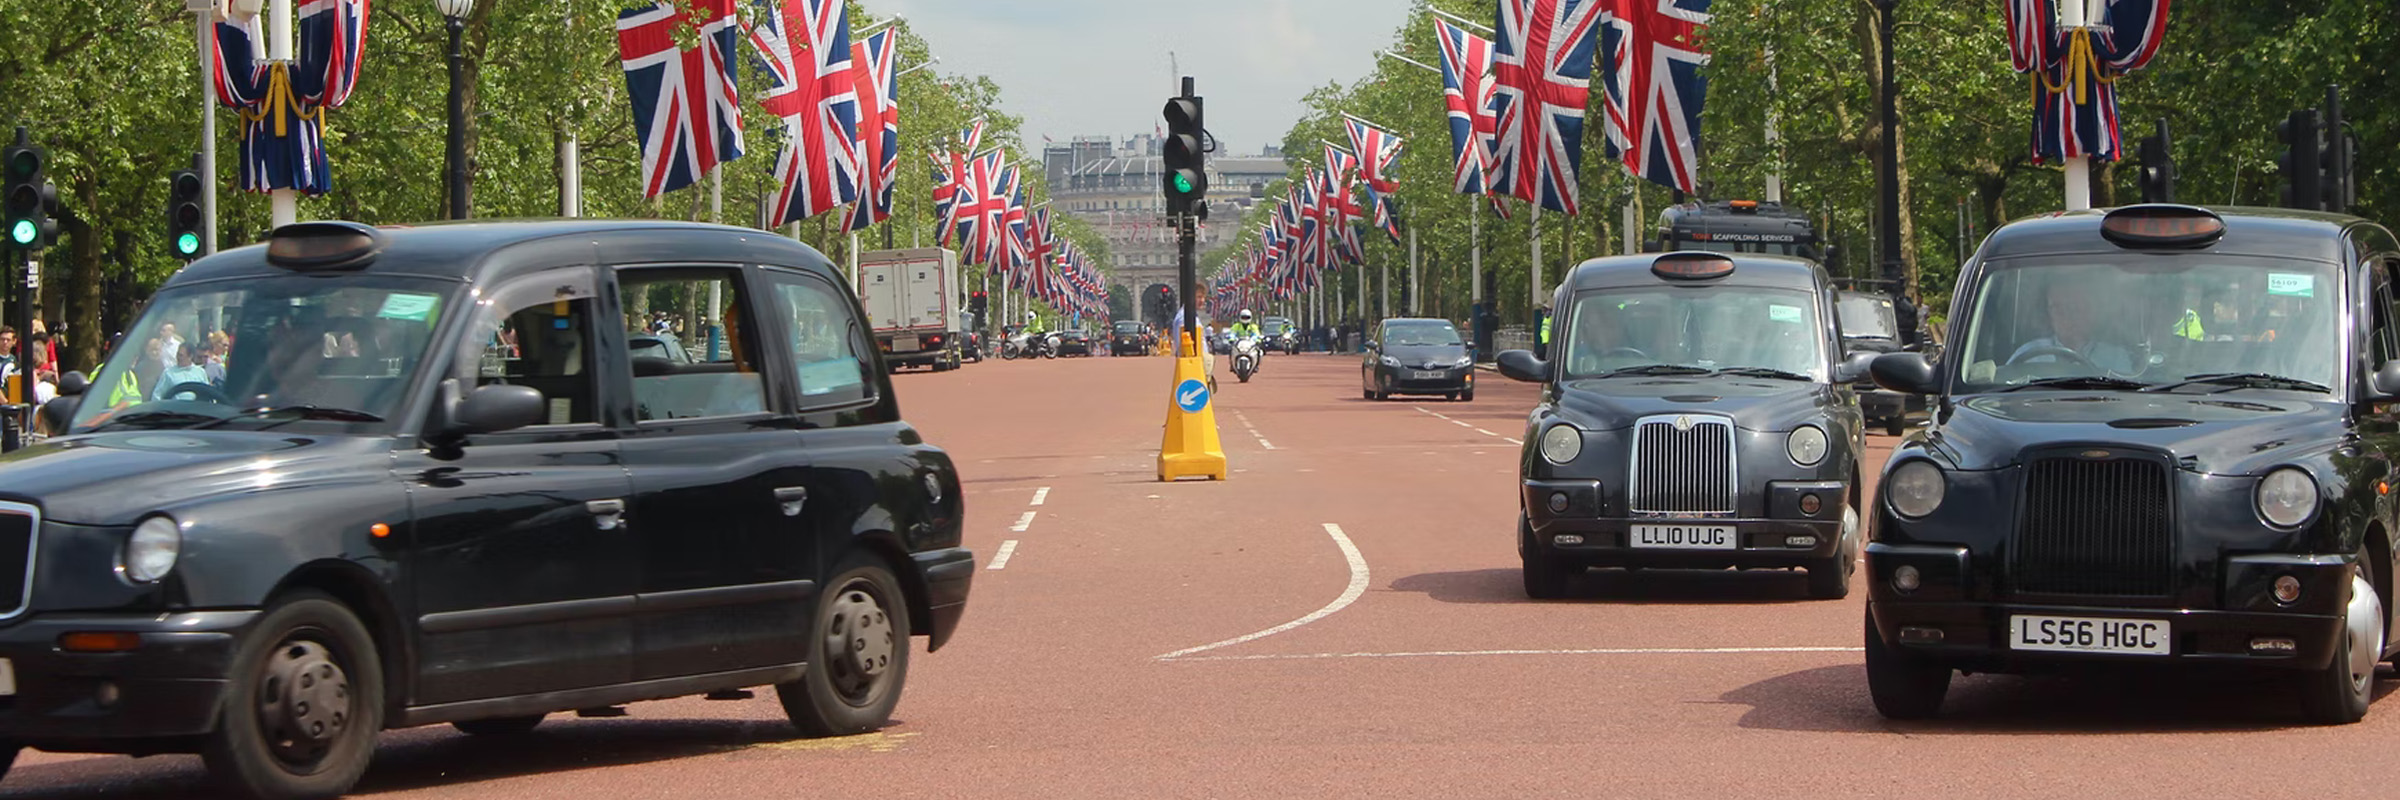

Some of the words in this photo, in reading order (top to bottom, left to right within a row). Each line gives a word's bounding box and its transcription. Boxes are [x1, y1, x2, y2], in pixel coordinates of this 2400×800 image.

[1712, 233, 1760, 242] SCAFFOLDING
[1761, 234, 1794, 242] SERVICES
[1678, 416, 1689, 428] A
[1642, 527, 1683, 544] LL10
[1688, 528, 1725, 545] UJG
[2022, 619, 2094, 646] LS56
[2103, 621, 2157, 648] HGC
